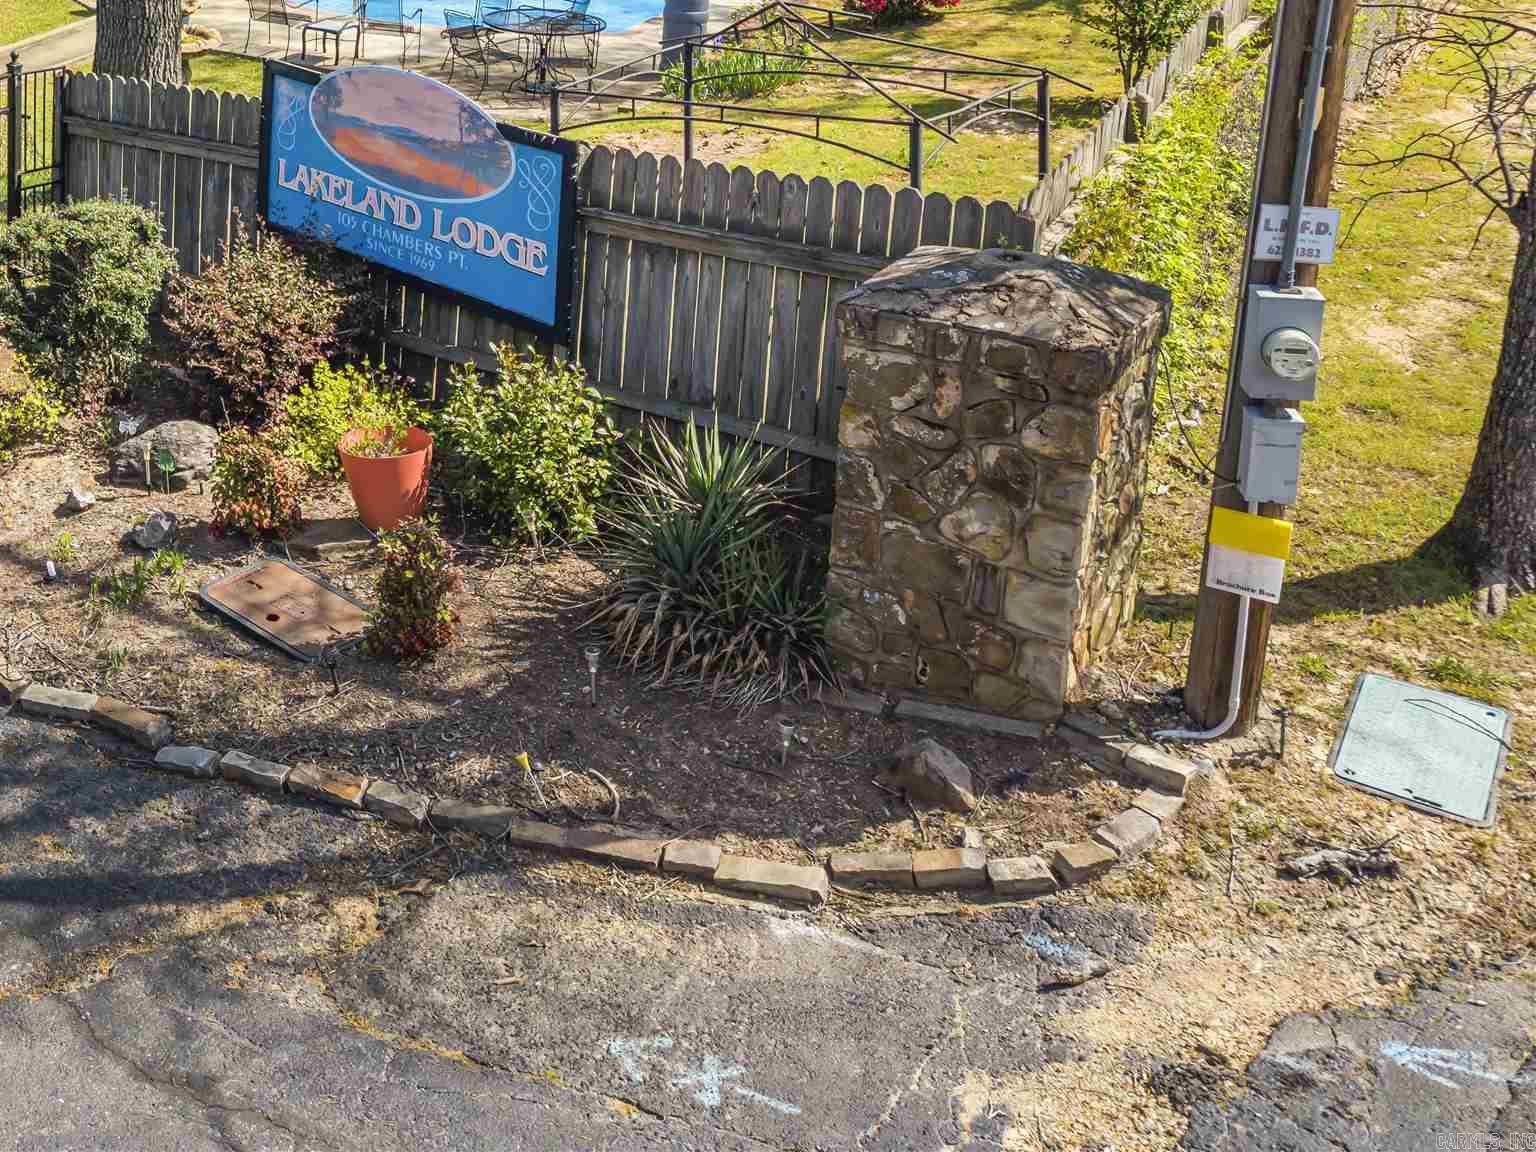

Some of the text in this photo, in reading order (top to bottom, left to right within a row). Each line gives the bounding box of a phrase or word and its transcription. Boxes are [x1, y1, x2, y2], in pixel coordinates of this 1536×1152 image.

[277, 158, 549, 277] LAKELAND LODGE
[361, 220, 442, 261] CHAMBERS
[448, 251, 469, 271] PT.
[365, 238, 436, 272] SINCE 1969
